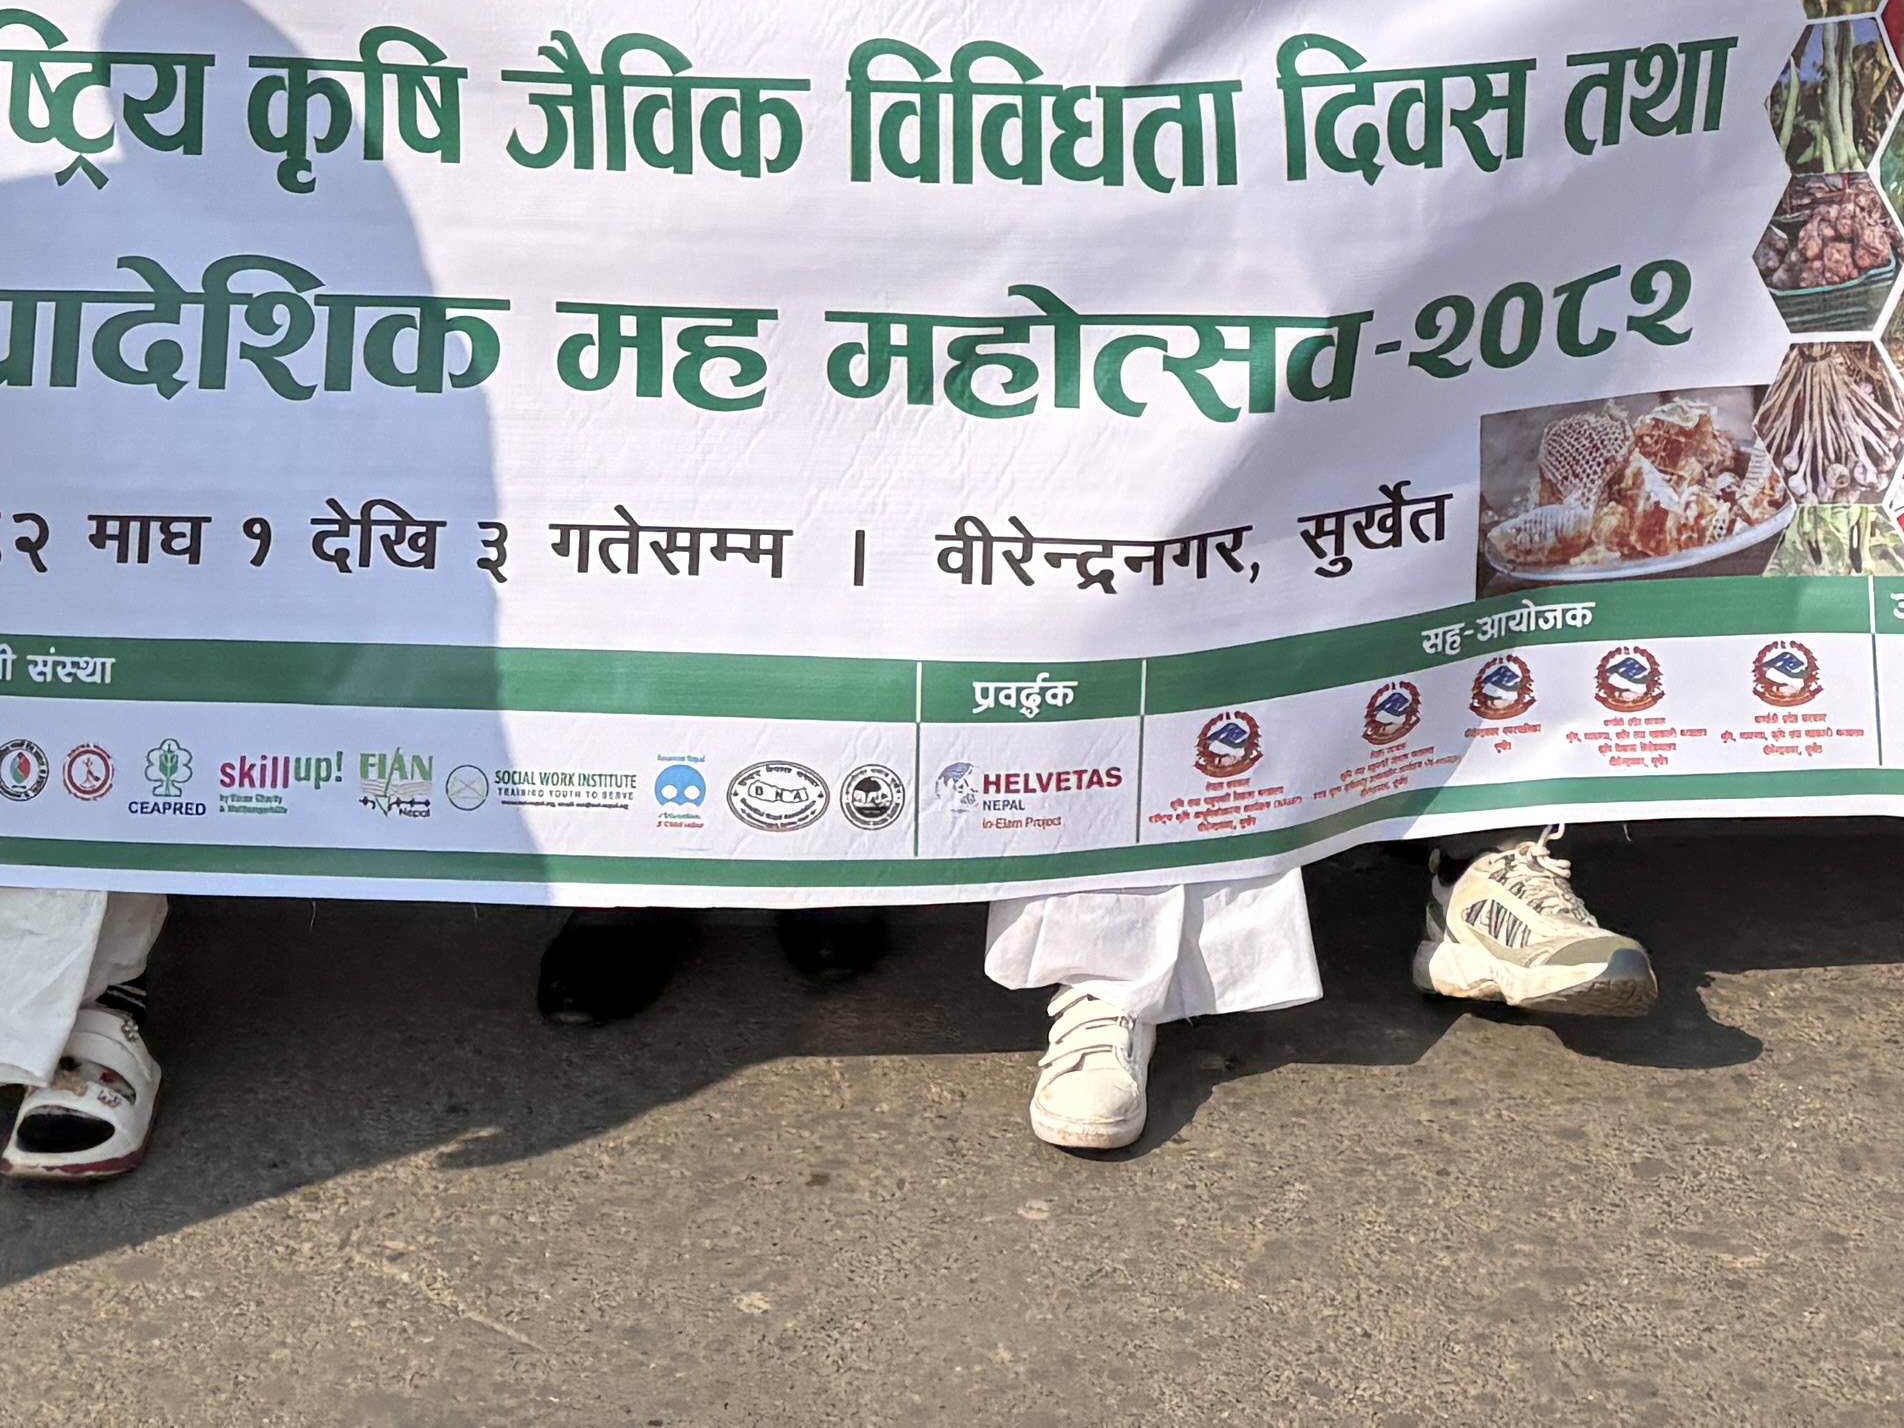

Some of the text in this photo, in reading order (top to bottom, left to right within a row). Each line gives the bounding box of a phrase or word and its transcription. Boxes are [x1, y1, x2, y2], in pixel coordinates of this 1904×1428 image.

[247, 25, 469, 195] कृषि
[500, 29, 811, 179] जैविक
[845, 29, 1243, 194] विविधता
[1276, 33, 1537, 187] दिवस
[1563, 35, 1739, 156] तथा
[555, 301, 779, 412] मह
[824, 258, 1702, 430] महोत्सव-२०८२
[87, 514, 213, 565] माघ
[242, 517, 272, 568] १
[310, 497, 448, 574] देखि
[476, 521, 508, 584] ३
[548, 504, 794, 579] गतेसम्म
[934, 515, 1260, 595] वीरेन्द्रनगर,
[1296, 479, 1454, 578] सुर्खेत
[1421, 600, 1596, 655] सह-आयोजक
[26, 646, 117, 684] संस्था
[359, 747, 434, 781] FIAN
[494, 769, 637, 789] SOCIAL WORK INSTITUTE
[982, 766, 1123, 795] HELVETAS
[127, 800, 207, 816] CEAPRED
[981, 797, 1026, 812] NEPAL
